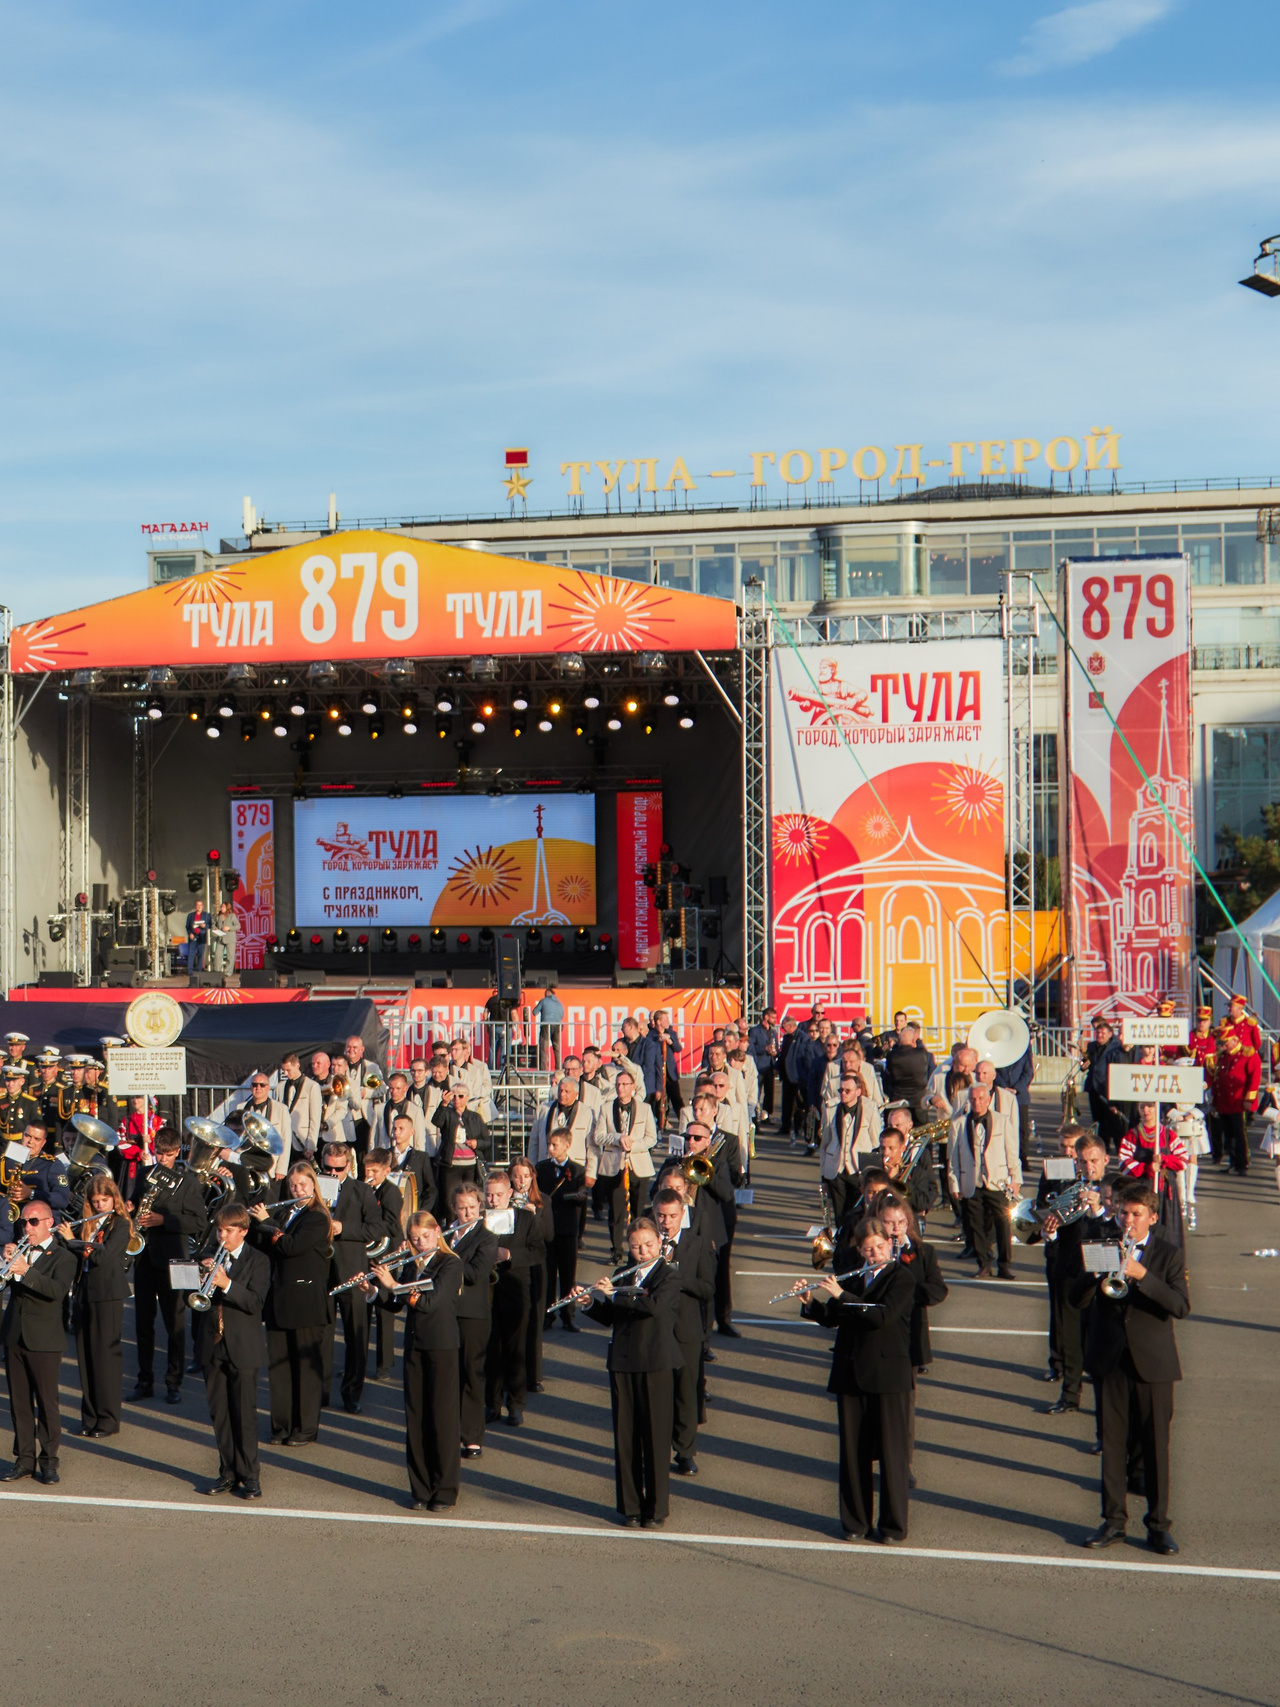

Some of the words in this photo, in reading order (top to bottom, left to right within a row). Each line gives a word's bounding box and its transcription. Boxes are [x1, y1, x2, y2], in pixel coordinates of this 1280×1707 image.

[560, 456, 698, 496] ТУЛА
[750, 426, 1122, 487] ГОРОД-ГЕРОЙ
[141, 521, 209, 534] МАГАДАН
[183, 600, 274, 648] ТУЛА
[300, 551, 419, 644] 879
[446, 589, 543, 639] ТУЛА
[1081, 574, 1175, 641] 879
[870, 670, 981, 723] ТУЛА
[797, 728, 842, 748] ГОРОД,
[844, 725, 905, 744] КОТОРЫЙ
[909, 725, 982, 743] ЗАРЯЖАЕТ
[237, 803, 270, 827] 879
[634, 797, 648, 827] ГОРОД!
[368, 830, 438, 859] ТУЛА
[322, 860, 350, 872] ГОРОД,
[352, 859, 391, 870] КОТОРЫЙ
[392, 860, 439, 870] ЗАРЯЖАЕТ
[323, 886, 330, 900] С
[335, 886, 423, 901] ПРАЗДНИКОМ,
[324, 904, 379, 918] ТУЛЯКИ!
[1131, 1024, 1180, 1039] ТАМБОВ
[110, 1052, 147, 1061] ВОЕННЫЙ
[150, 1052, 183, 1061] ОРКЕСТР
[115, 1062, 179, 1071] ЧЕРНОМОРСКОГО
[134, 1073, 160, 1081] ФЛОТА
[1131, 1073, 1182, 1094] ТУЛА
